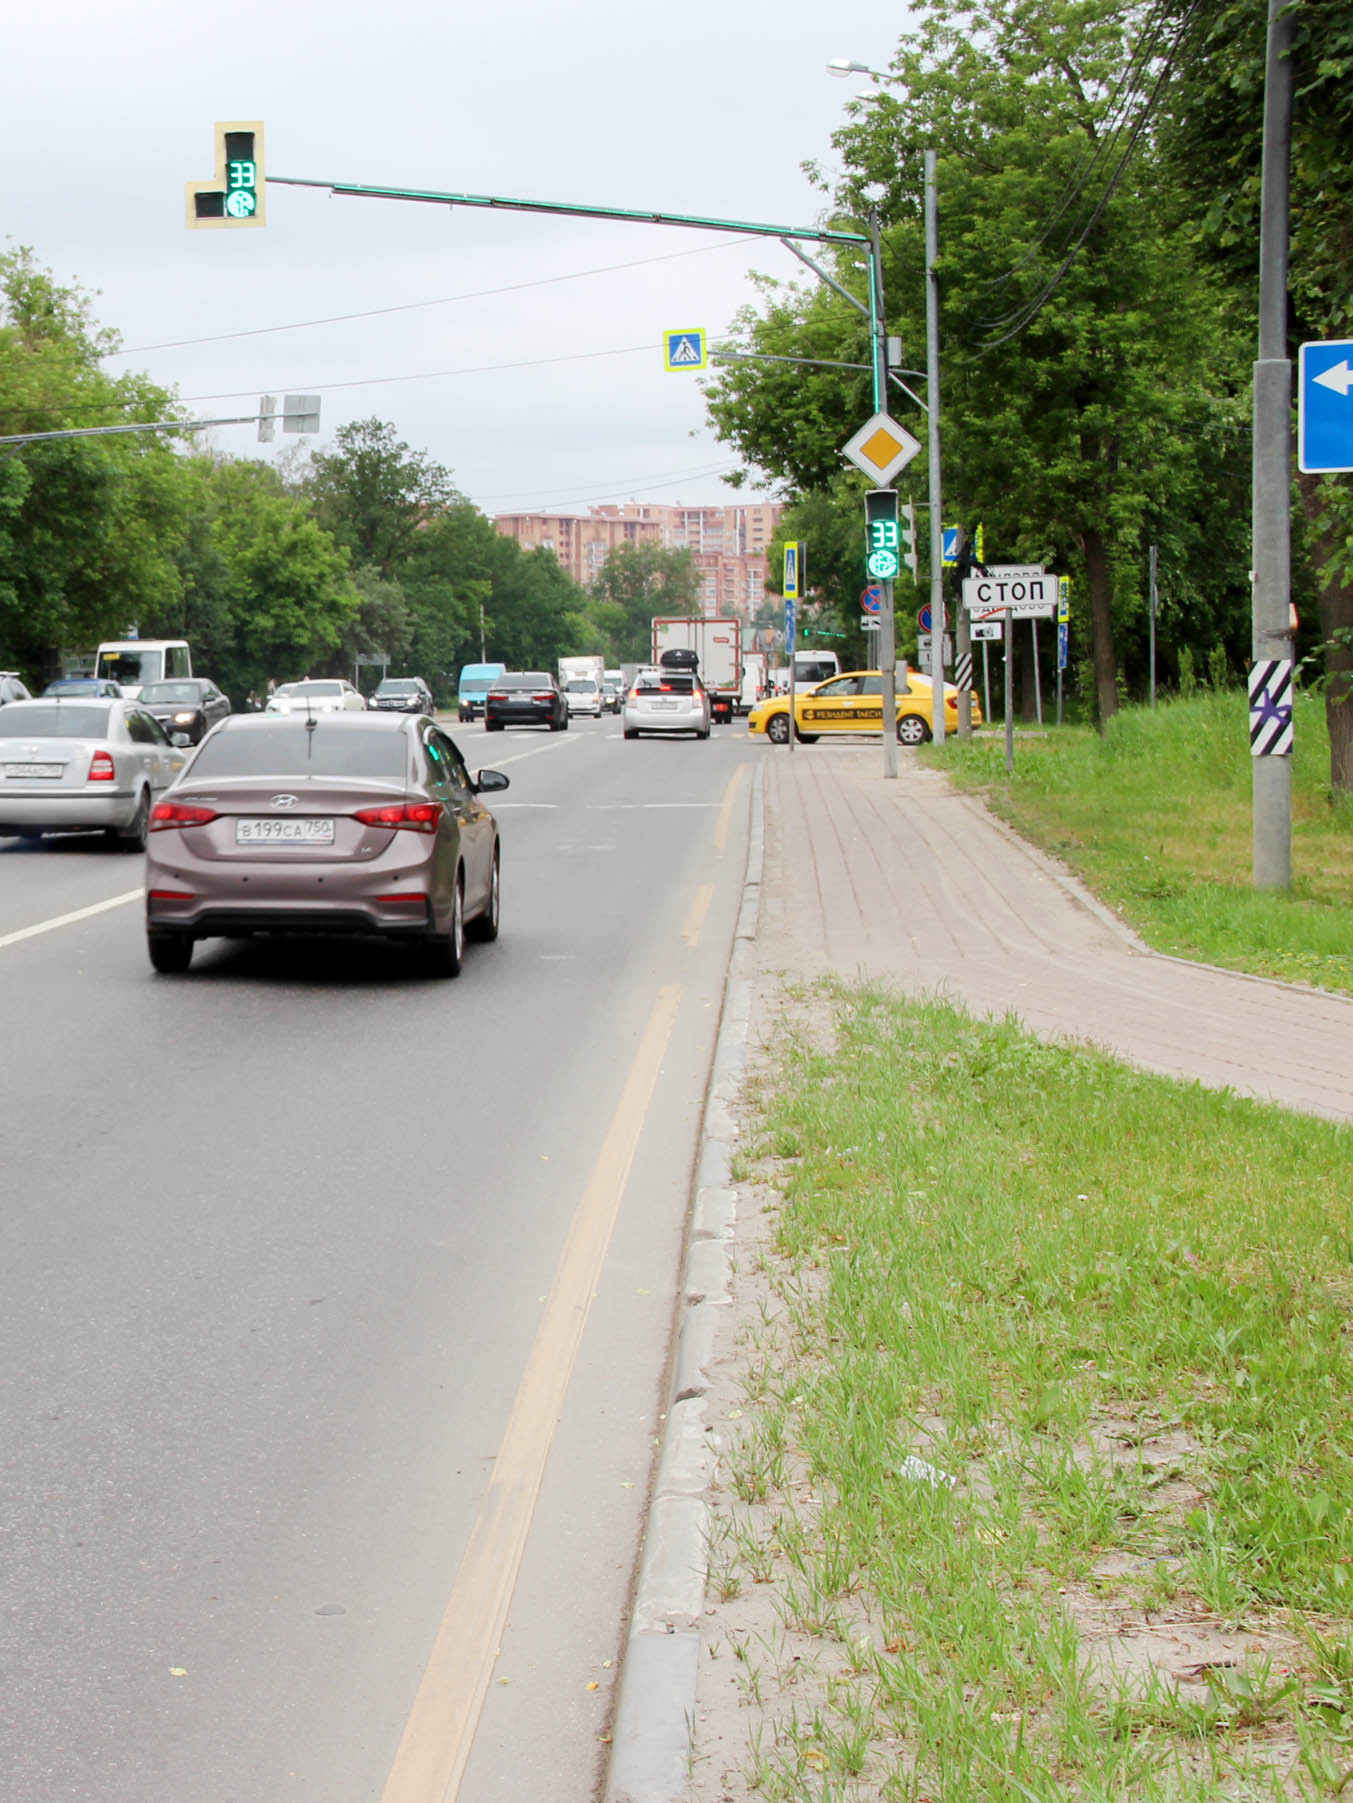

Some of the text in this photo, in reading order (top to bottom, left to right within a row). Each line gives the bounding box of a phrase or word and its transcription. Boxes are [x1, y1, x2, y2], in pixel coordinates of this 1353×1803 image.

[230, 162, 255, 188] 33
[872, 522, 898, 548] 33
[977, 581, 1044, 602] СТОП
[305, 820, 330, 833] 750
